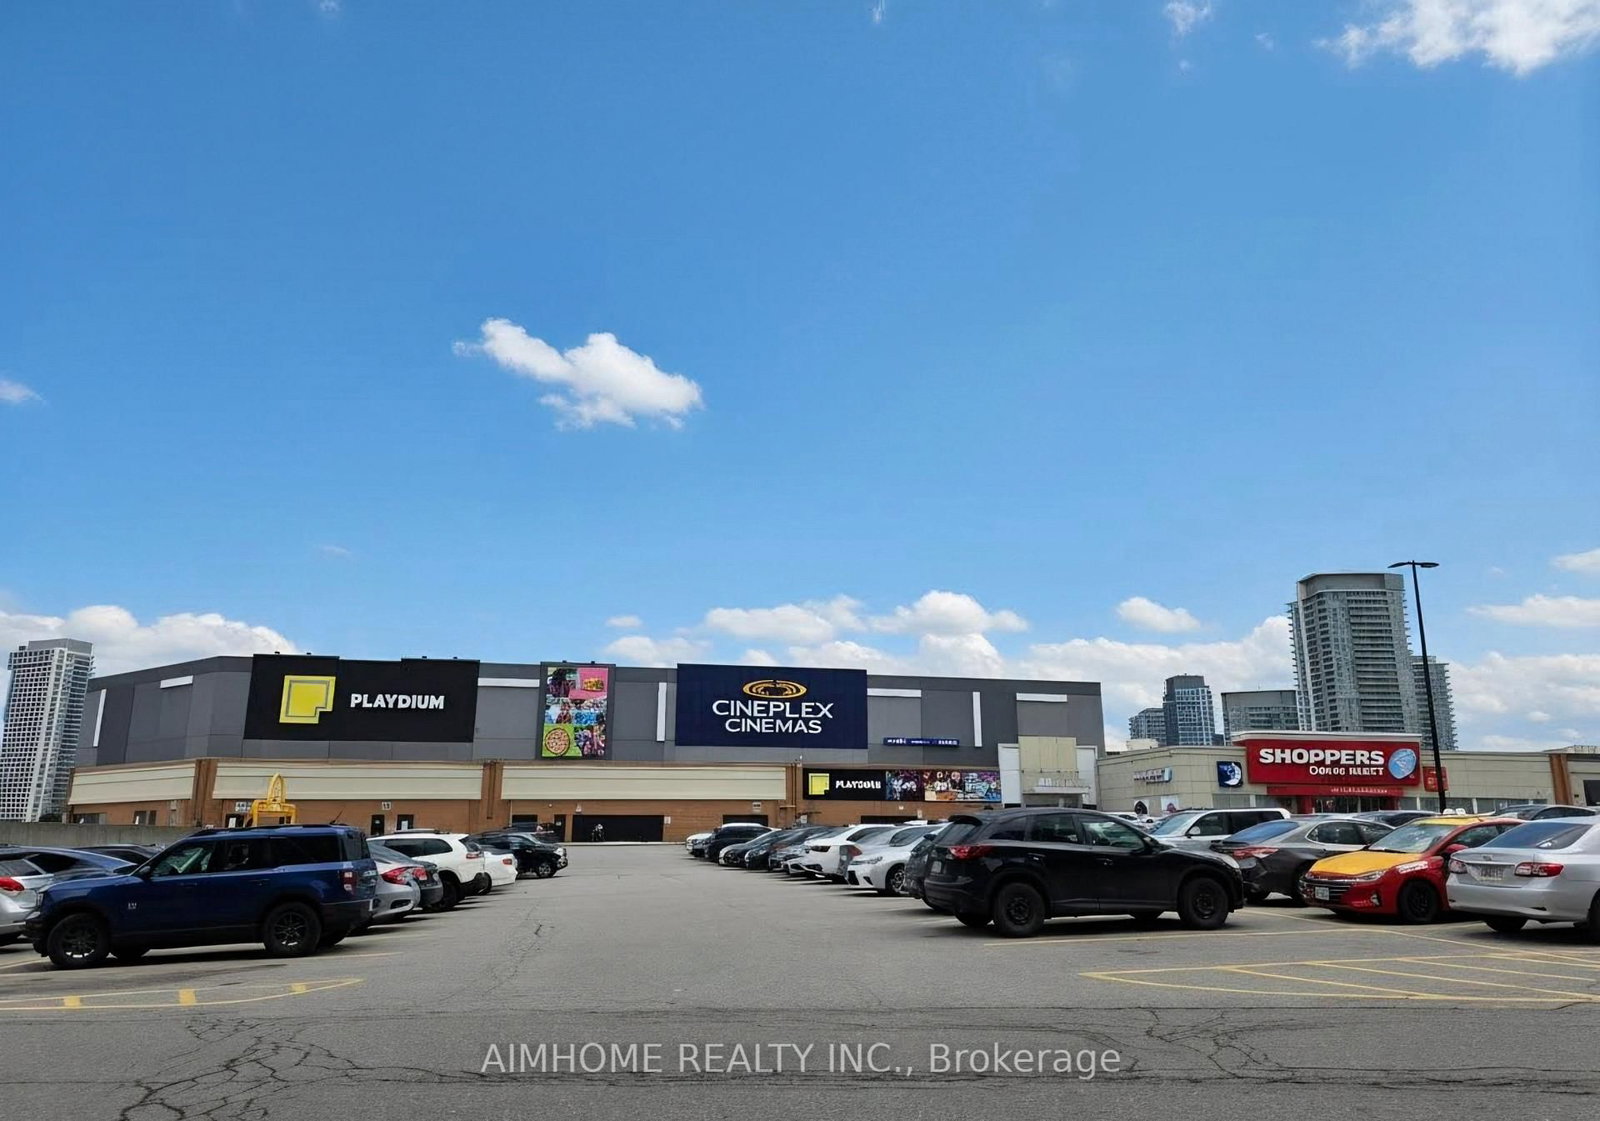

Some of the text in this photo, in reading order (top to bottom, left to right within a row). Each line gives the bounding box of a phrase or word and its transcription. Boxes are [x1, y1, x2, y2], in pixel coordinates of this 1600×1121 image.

[350, 693, 445, 710] PLAYDIUM
[712, 699, 834, 718] CINEPLEX
[725, 718, 822, 734] CINEMAS
[1259, 748, 1385, 765] SHOPPERS
